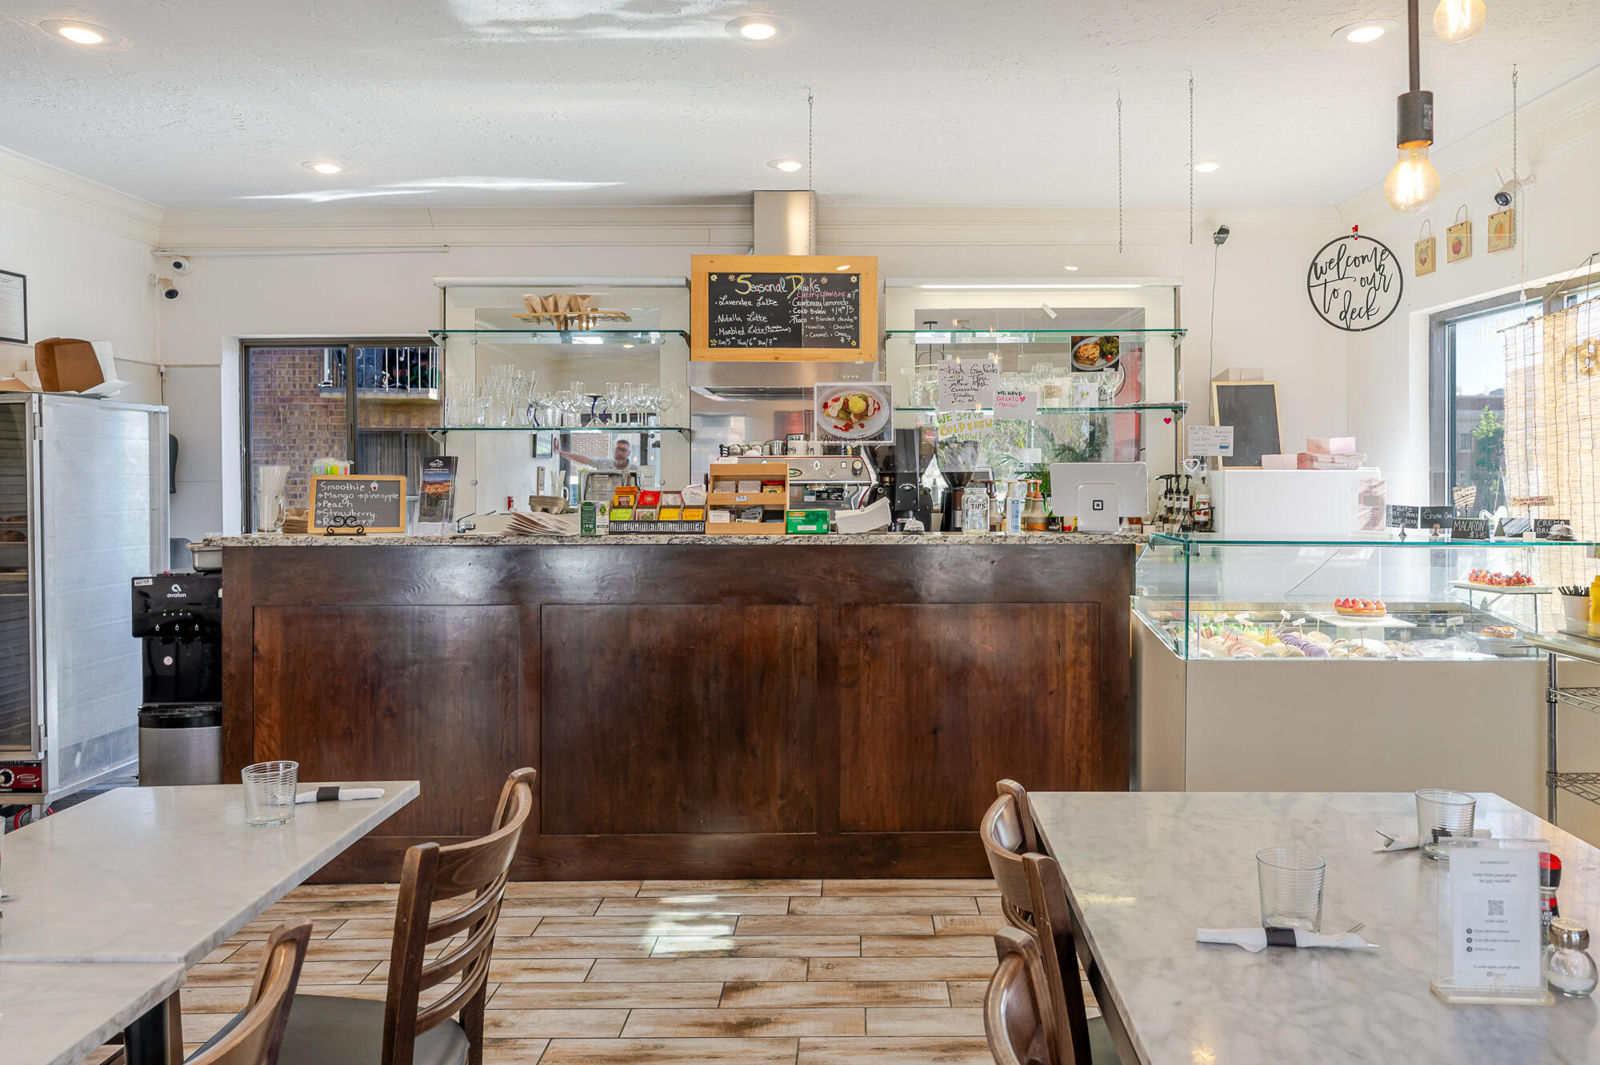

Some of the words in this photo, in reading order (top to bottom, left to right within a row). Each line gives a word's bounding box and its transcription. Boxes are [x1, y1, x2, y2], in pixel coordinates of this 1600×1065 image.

[1313, 243, 1391, 280] welcome
[734, 274, 788, 295] Seasonal
[1360, 270, 1393, 293] our
[756, 296, 779, 307] Latte
[1339, 287, 1380, 329] deck
[746, 311, 769, 323] Latte
[936, 413, 953, 424] WE
[939, 422, 966, 437] COLD
[320, 481, 365, 491] Smoothie
[322, 500, 353, 508] Peach
[324, 492, 355, 504] Mango
